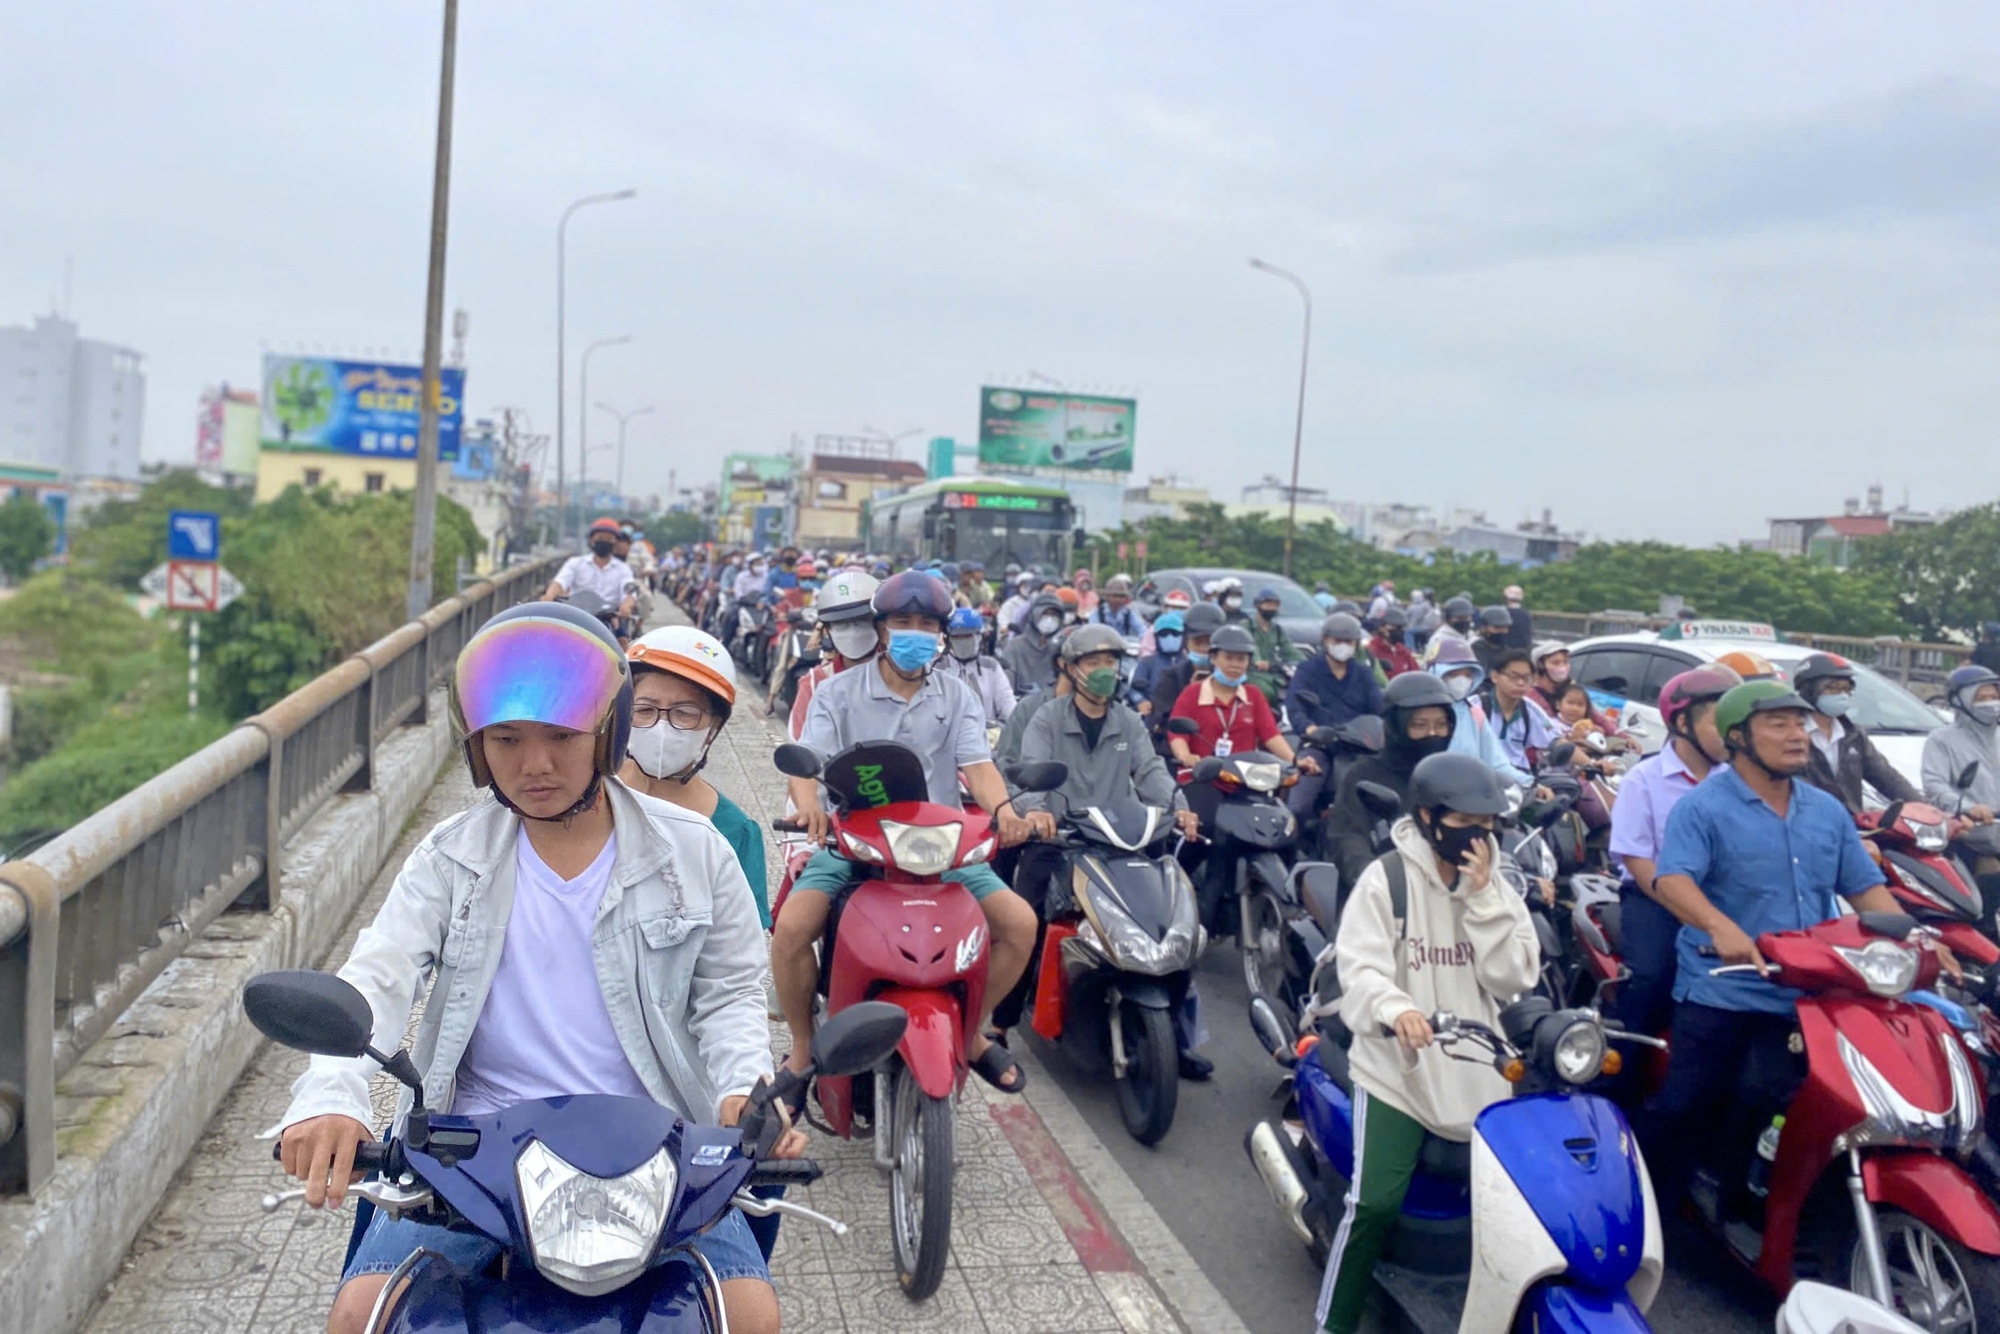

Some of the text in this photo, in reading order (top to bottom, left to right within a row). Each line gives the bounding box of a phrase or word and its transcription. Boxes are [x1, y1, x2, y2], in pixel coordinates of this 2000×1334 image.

[1701, 624, 1772, 636] VINASUN TAXI
[902, 899, 938, 907] HONDA
